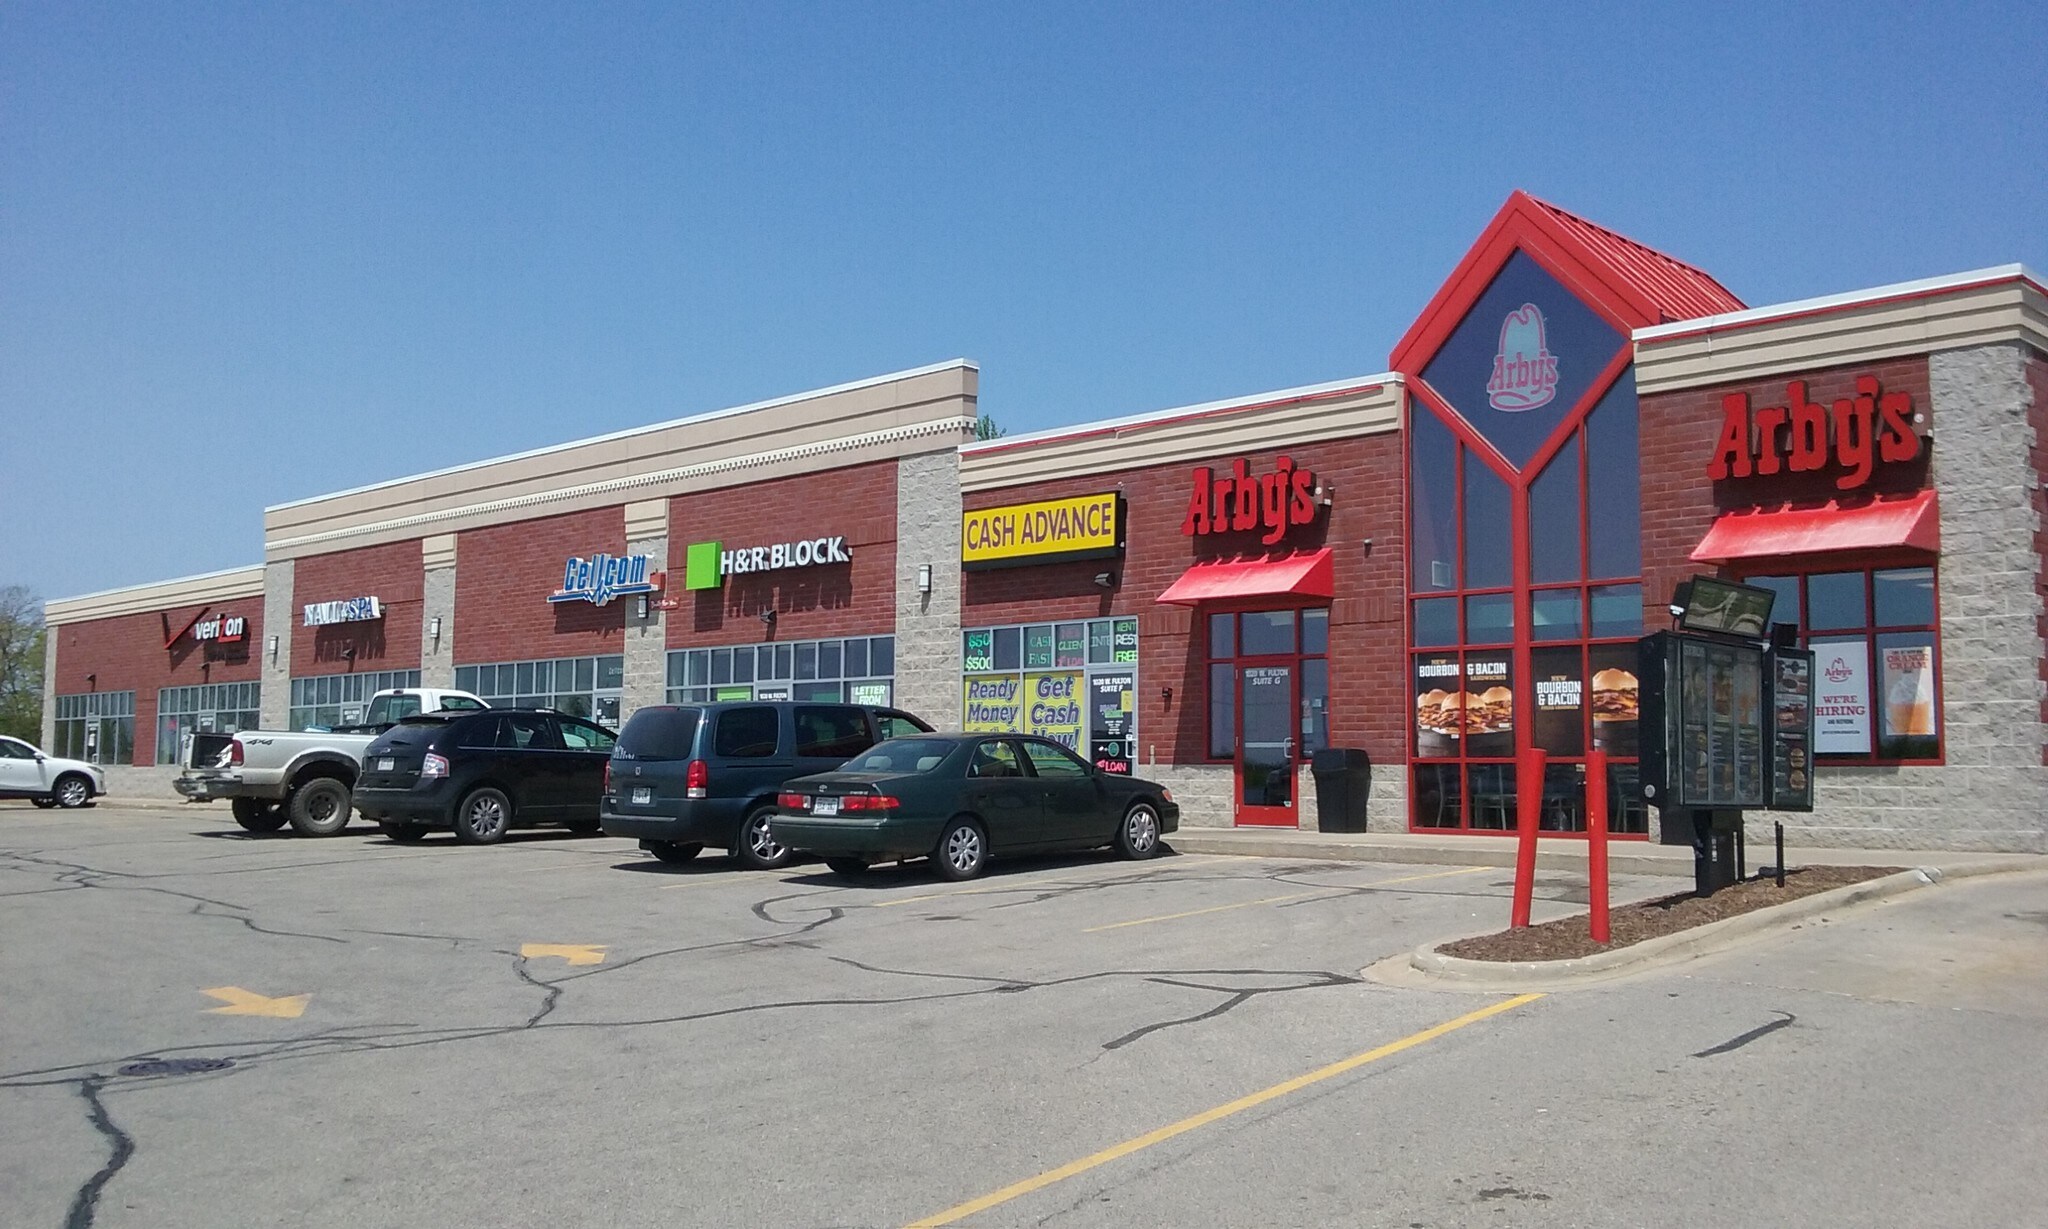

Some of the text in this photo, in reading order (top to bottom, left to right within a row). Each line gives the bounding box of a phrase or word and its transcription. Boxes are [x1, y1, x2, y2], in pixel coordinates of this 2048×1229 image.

[1488, 351, 1558, 395] Arby's
[1707, 375, 1919, 489] Arby's
[1181, 456, 1315, 545] Arby's
[967, 502, 1112, 550] CASH ADVANCE
[720, 536, 849, 575] H&R BLOCK
[565, 553, 648, 591] Cellcom
[350, 596, 379, 620] SPA
[195, 613, 243, 642] verizon
[1420, 662, 1507, 677] BOURBON & BACON
[855, 685, 886, 696] LETTER
[968, 677, 1018, 701] Ready
[1037, 675, 1075, 698] Get
[1100, 685, 1117, 693] SUITE
[1112, 677, 1131, 685] FULTON
[1252, 677, 1281, 685] SUITE G
[1536, 681, 1582, 694] BOURBON
[858, 695, 882, 705] FROM
[1538, 693, 1580, 705] & BACON
[1823, 695, 1858, 704] WE'RE
[967, 703, 1019, 725] Money
[1031, 701, 1080, 725] Cash
[1815, 705, 1866, 716] HIRING
[1105, 761, 1127, 771] LOAN
